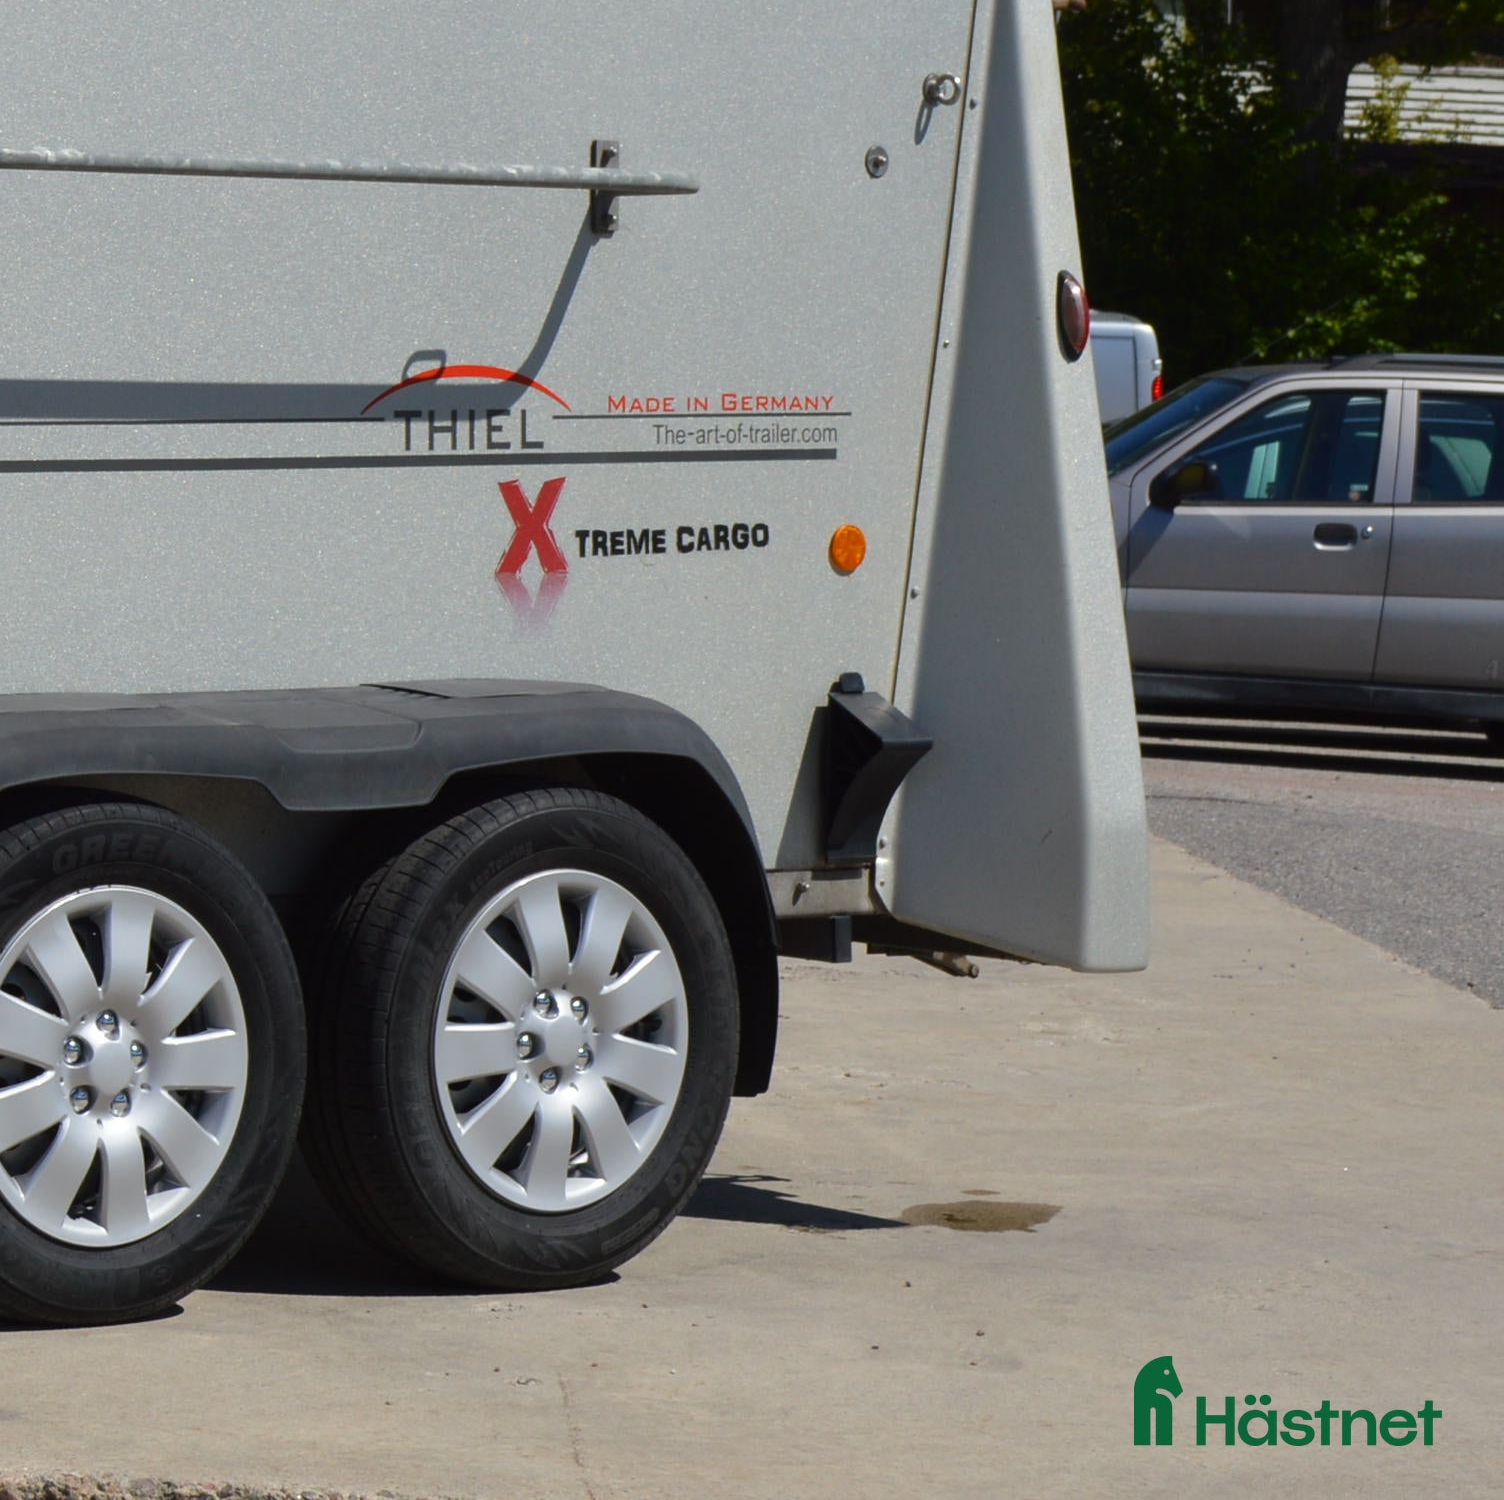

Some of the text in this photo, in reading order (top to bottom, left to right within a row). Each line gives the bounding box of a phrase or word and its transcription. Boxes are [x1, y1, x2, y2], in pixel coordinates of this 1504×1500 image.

[394, 409, 545, 451] THIEL
[652, 423, 838, 446] The-art-of-trailer.com
[676, 522, 770, 554] CARGO
